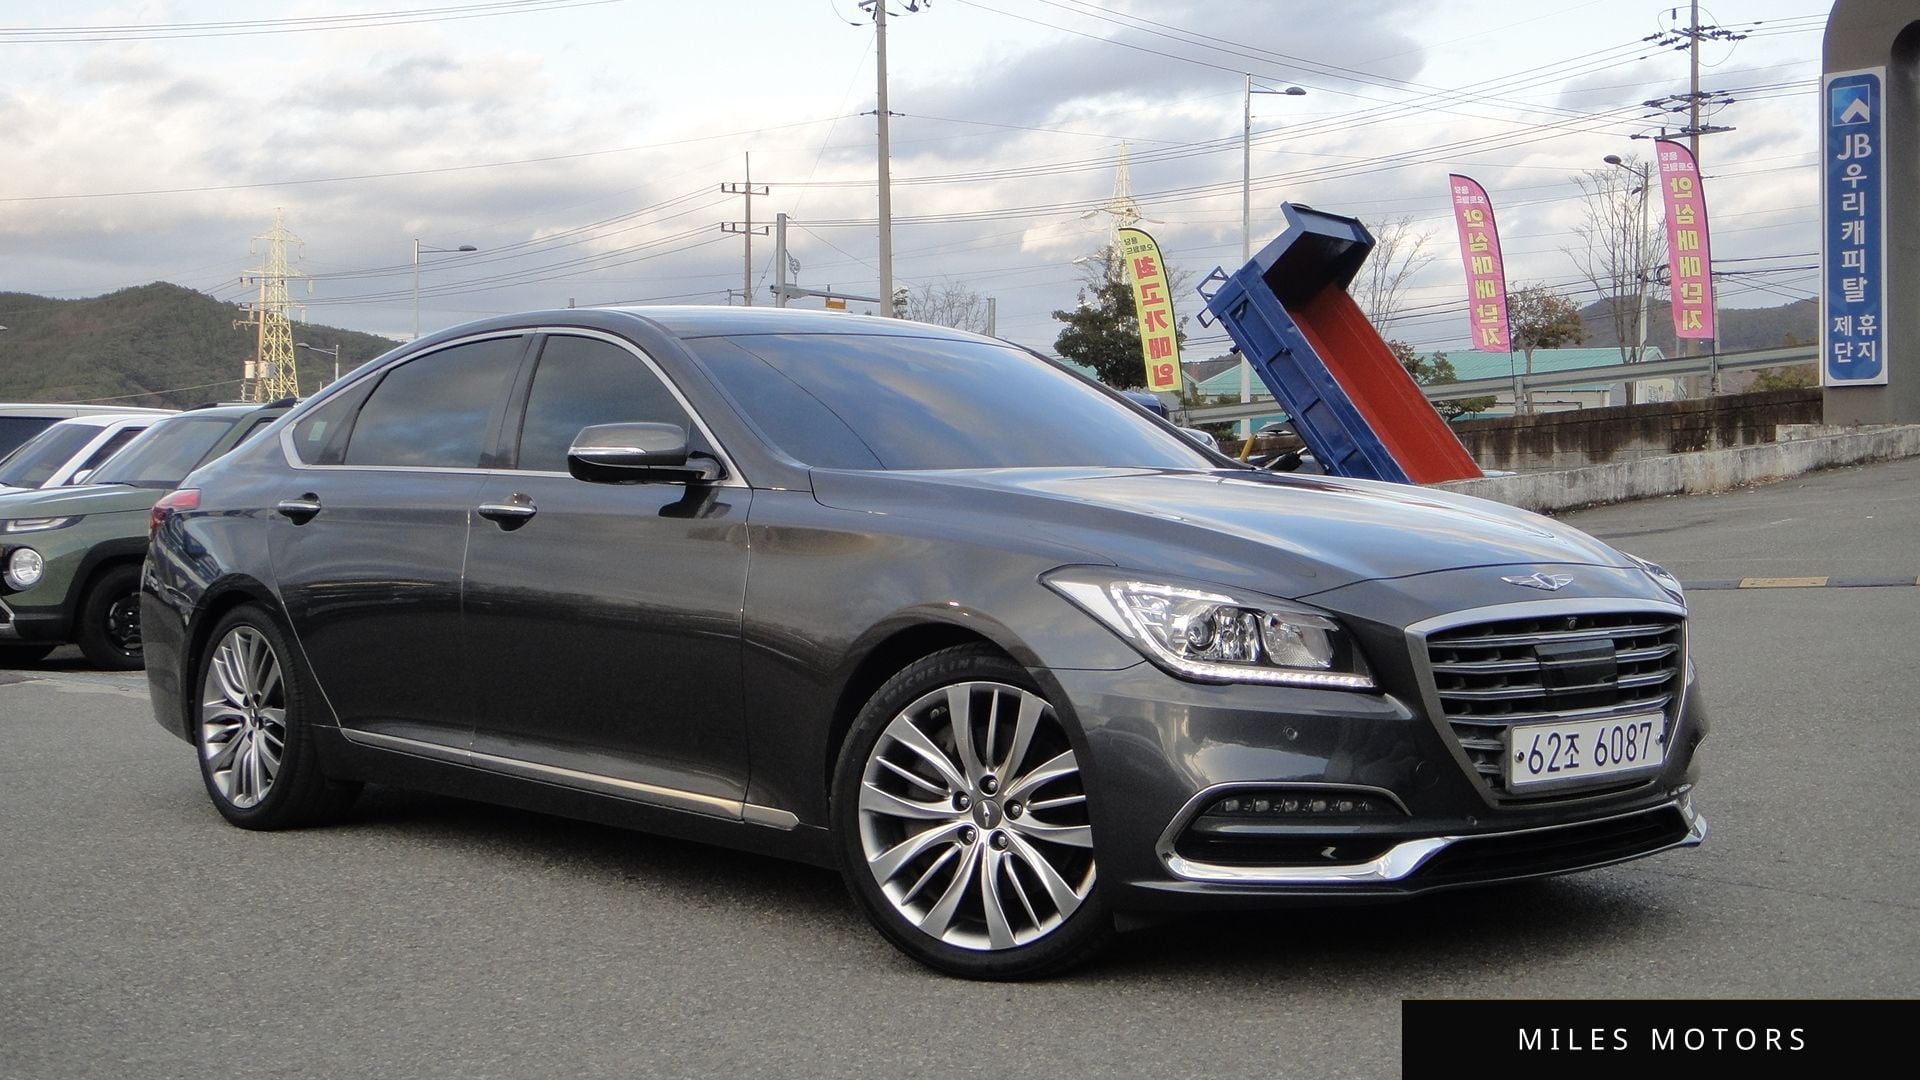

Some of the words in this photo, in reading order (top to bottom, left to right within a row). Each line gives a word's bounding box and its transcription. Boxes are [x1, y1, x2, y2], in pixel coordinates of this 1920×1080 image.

[1834, 314, 1877, 336] 제휴
[1834, 340, 1876, 363] 단지
[1528, 732, 1580, 775] 62조
[1593, 721, 1653, 767] 6087
